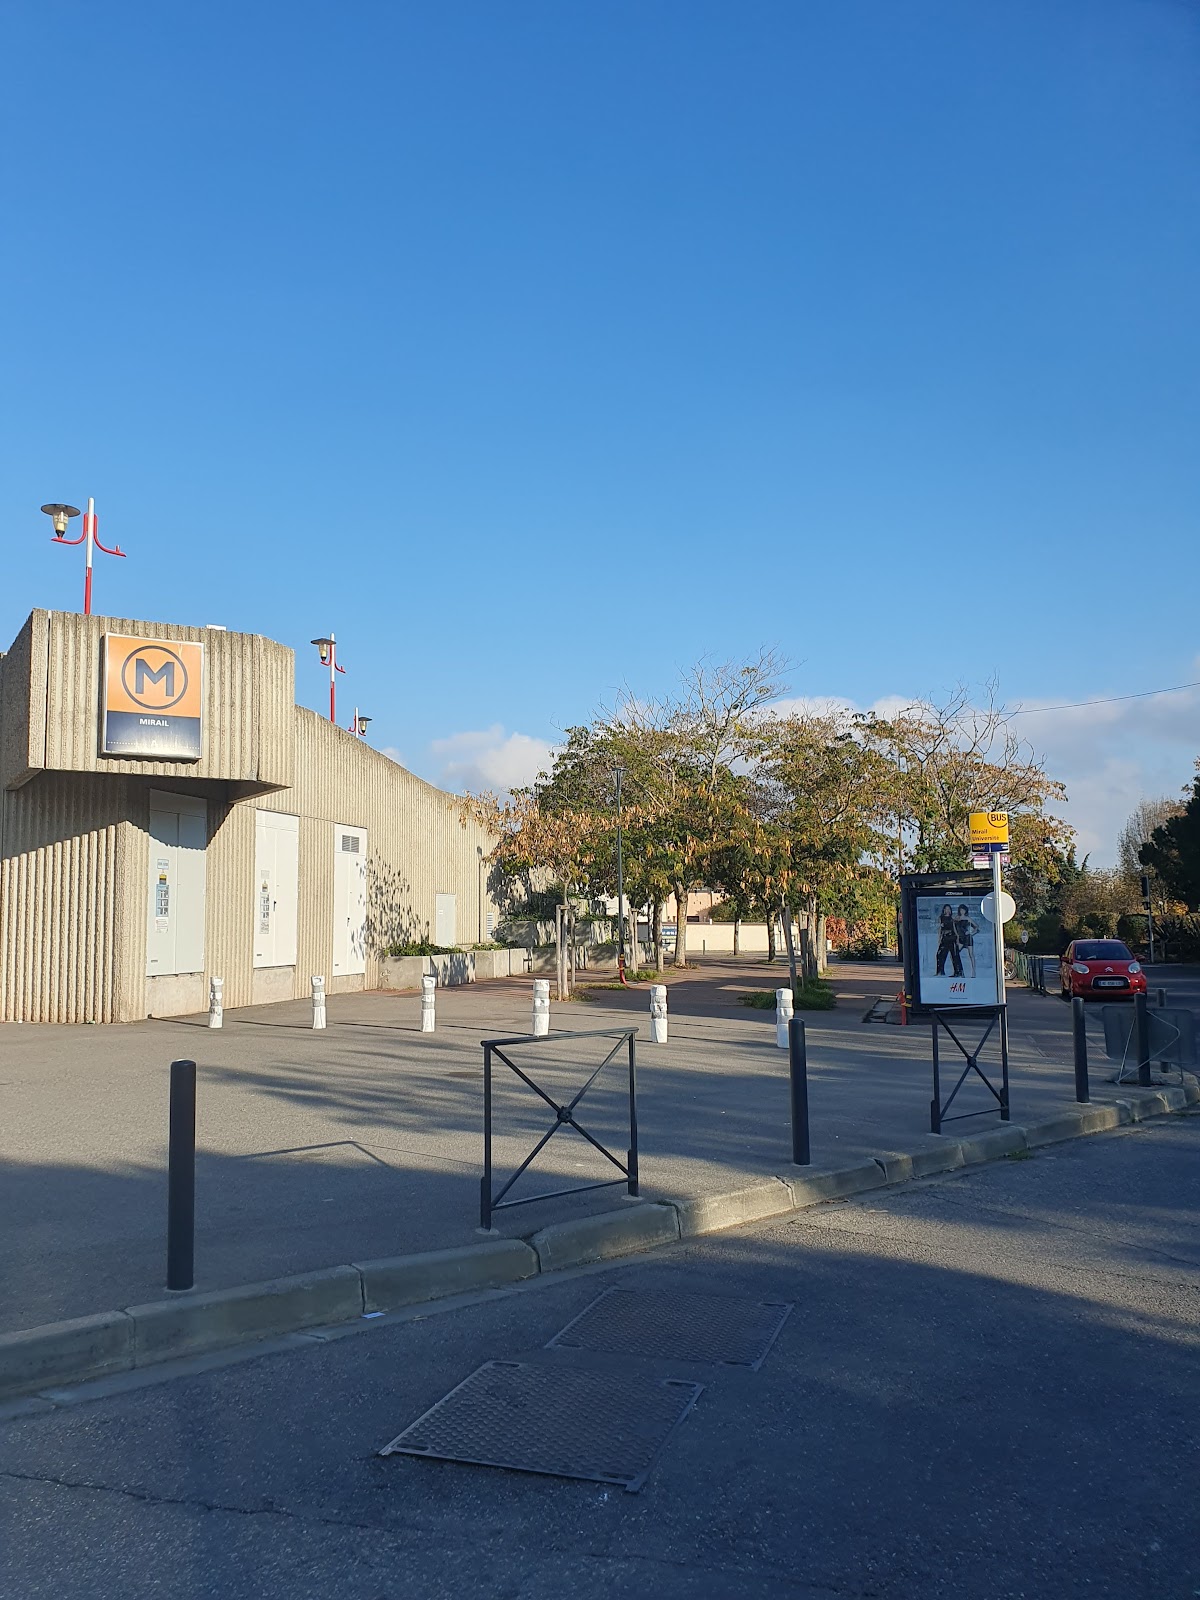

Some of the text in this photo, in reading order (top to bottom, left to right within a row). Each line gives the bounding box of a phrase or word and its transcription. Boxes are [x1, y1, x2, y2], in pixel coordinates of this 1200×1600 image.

[135, 658, 175, 697] M
[139, 718, 170, 727] MIRAIL
[990, 813, 1007, 821] BUS
